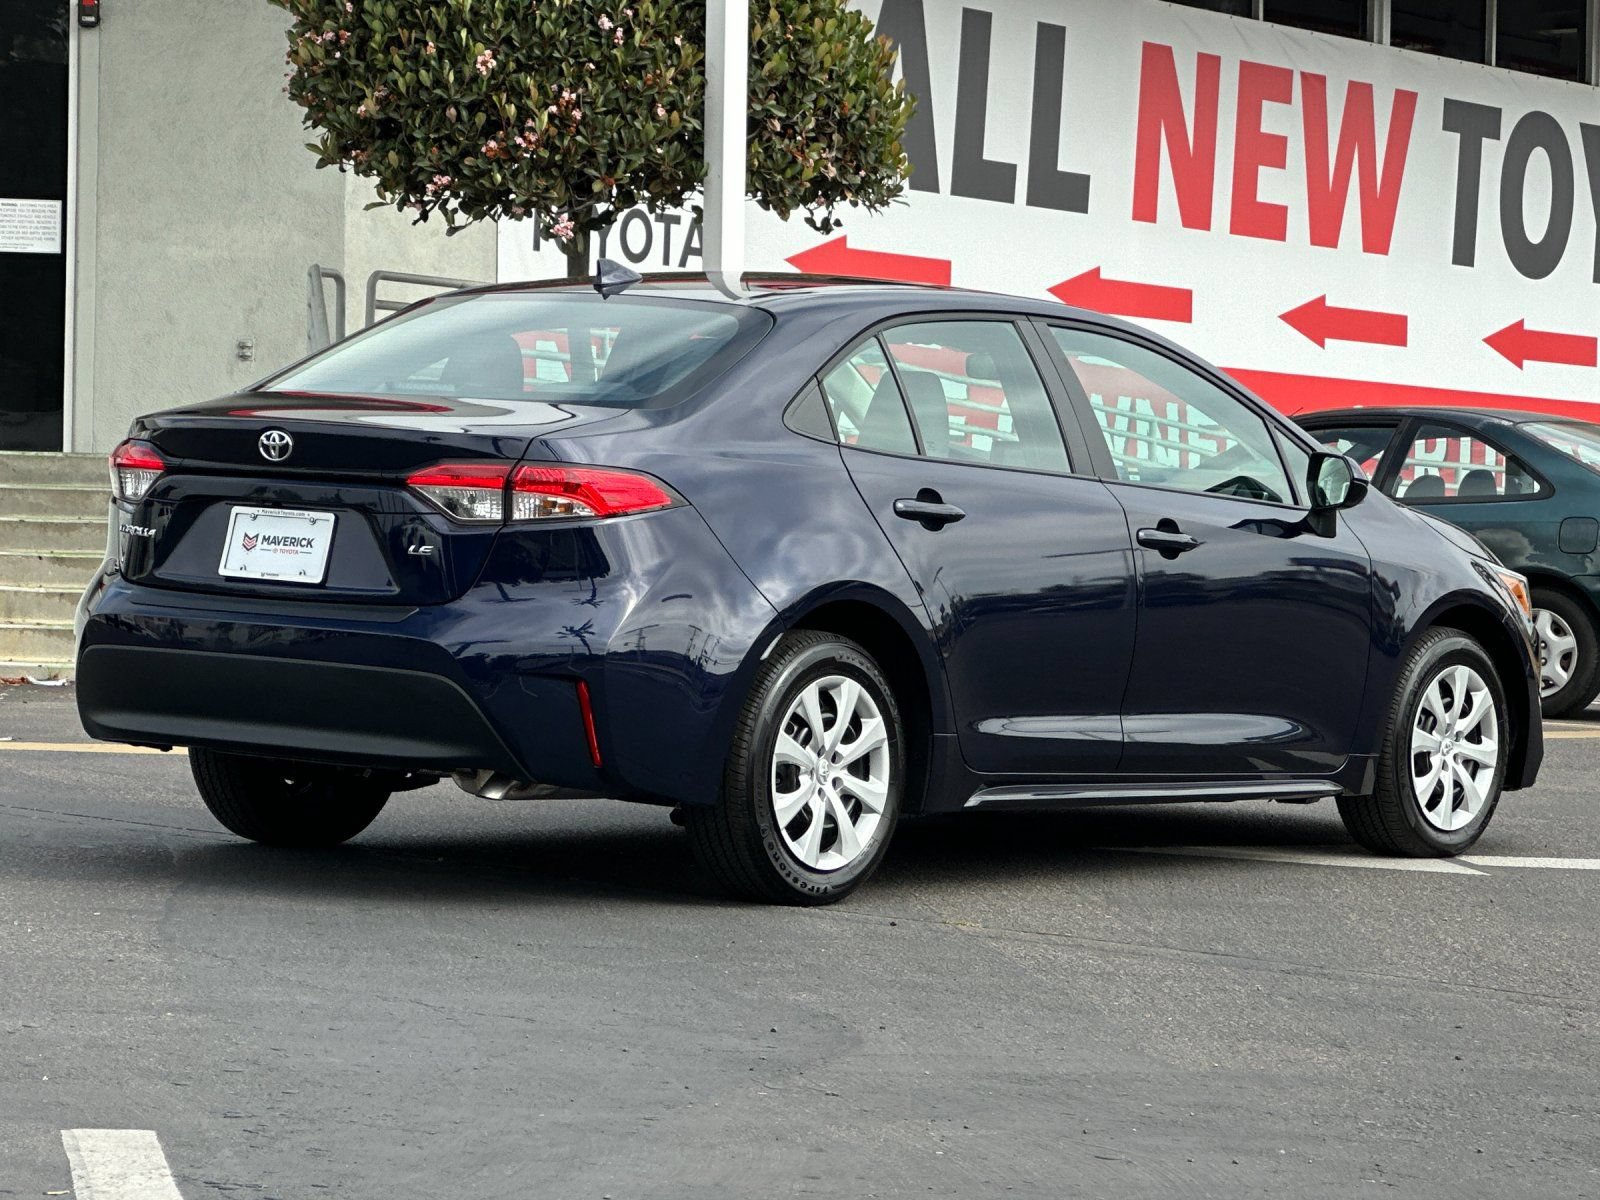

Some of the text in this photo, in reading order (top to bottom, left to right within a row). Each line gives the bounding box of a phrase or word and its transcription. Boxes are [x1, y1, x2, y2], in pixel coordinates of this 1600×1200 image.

[873, 0, 1091, 214] ALL
[1132, 41, 1418, 256] NEW
[533, 203, 703, 268] YOTA
[261, 535, 314, 548] MAVERICK
[407, 544, 434, 555] LE
